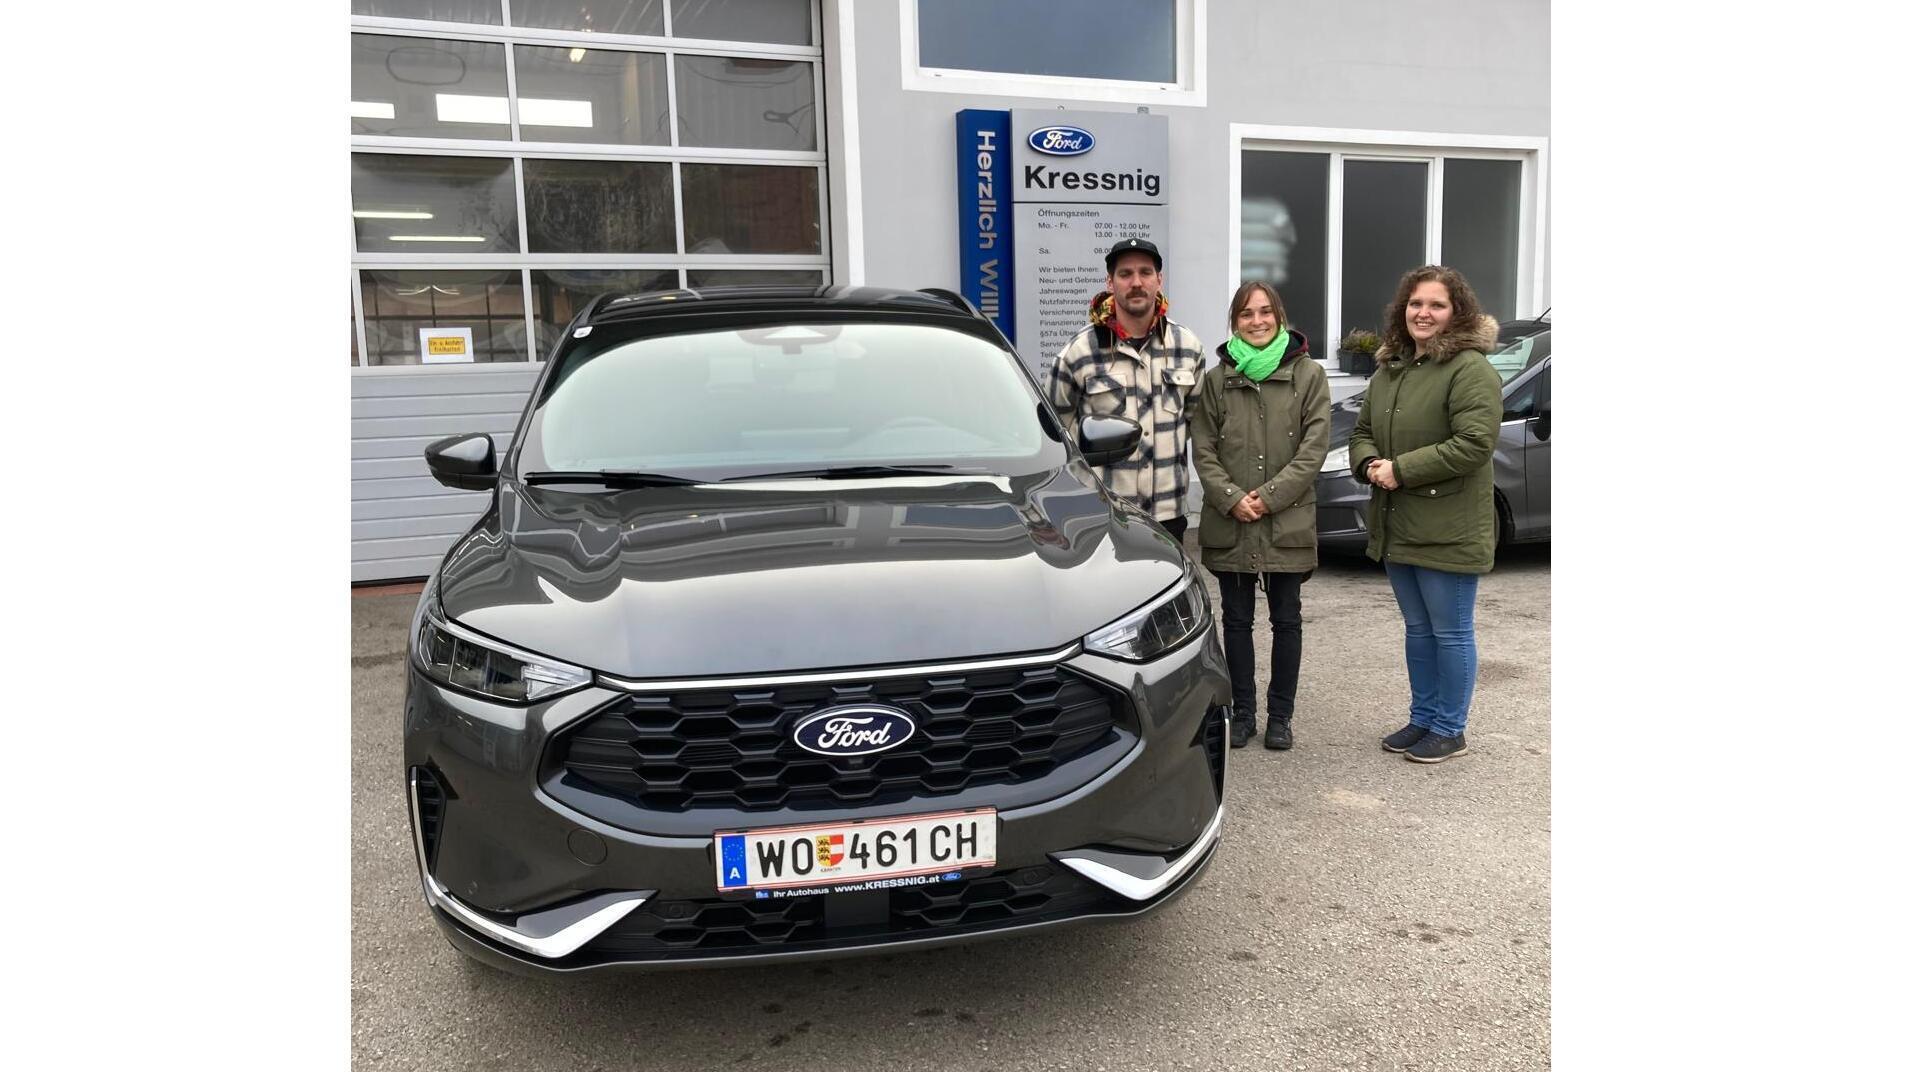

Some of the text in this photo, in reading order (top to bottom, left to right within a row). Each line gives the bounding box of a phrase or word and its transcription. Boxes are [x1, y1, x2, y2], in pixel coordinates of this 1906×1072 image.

[1042, 130, 1083, 150] Ford
[977, 131, 998, 249] Herzlich
[1024, 165, 1160, 196] Kressnig
[1038, 207, 1100, 219] Öffnungszeiten
[1039, 288, 1088, 296] Jahreswagen
[1040, 319, 1086, 327] Finanzierung
[817, 716, 893, 749] Ford
[756, 821, 978, 878] WO 461 CH
[729, 867, 741, 880] A
[773, 889, 786, 898] Ihr
[786, 887, 830, 898] Autohaus
[834, 874, 940, 893] www.KRESSNIG.at
